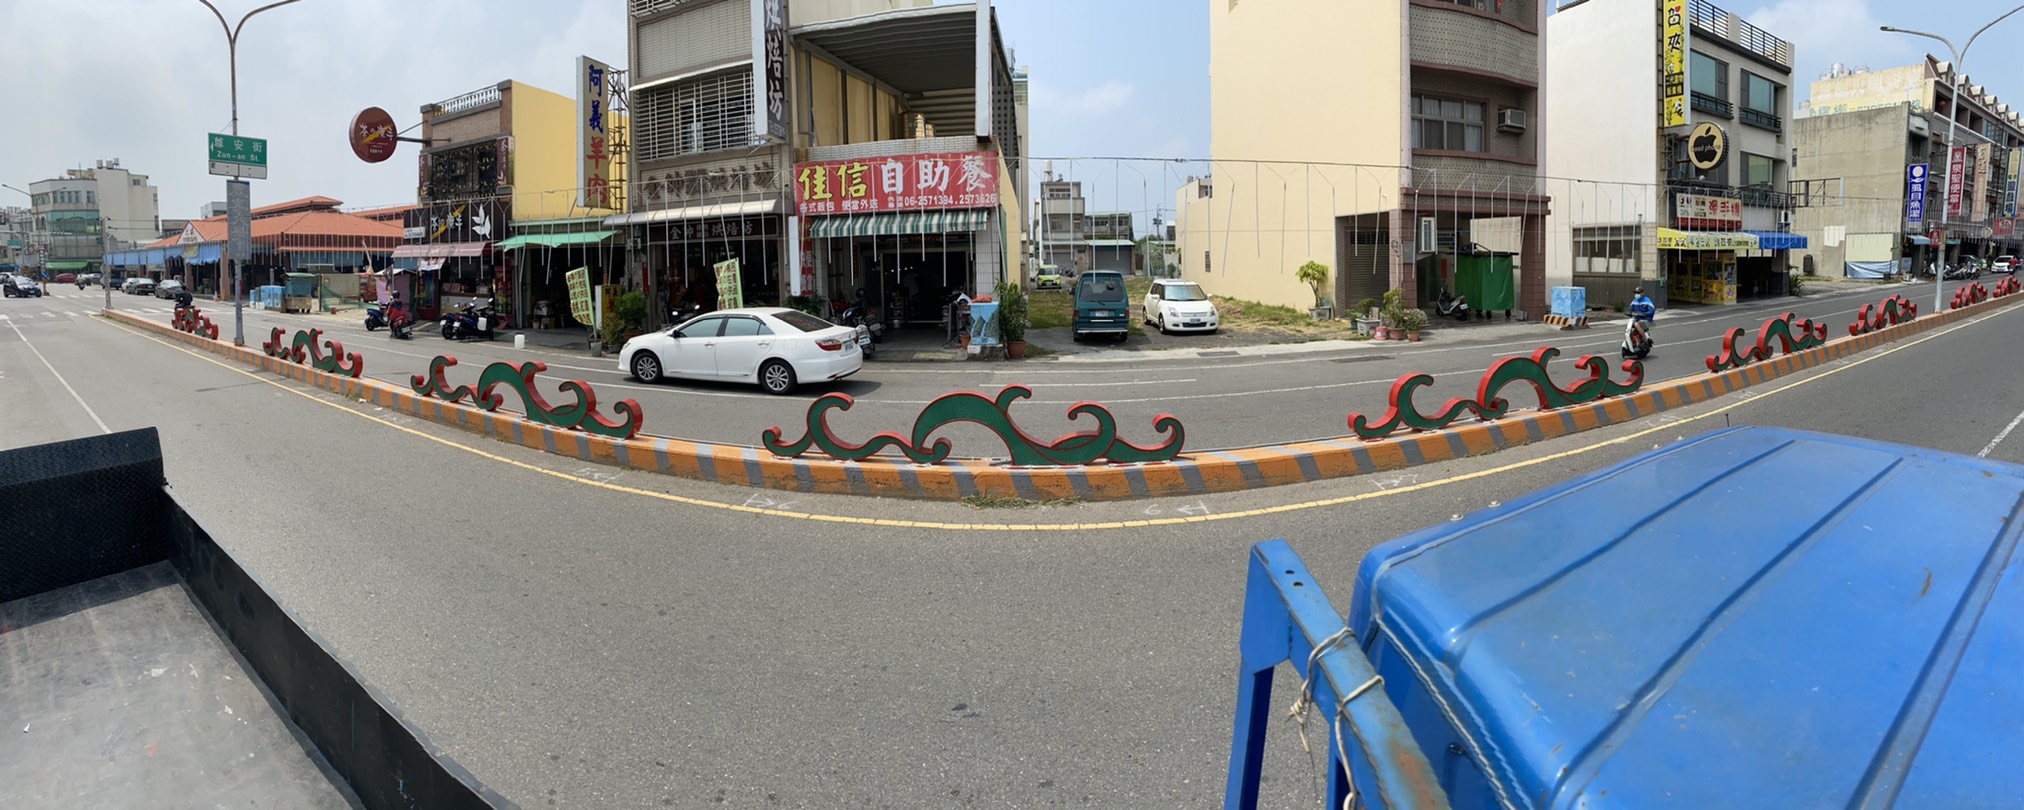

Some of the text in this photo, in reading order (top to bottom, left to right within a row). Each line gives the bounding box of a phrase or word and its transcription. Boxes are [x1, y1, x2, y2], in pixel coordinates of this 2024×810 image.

[217, 150, 246, 160] Zun-an
[586, 63, 608, 204] 阿義羊肉
